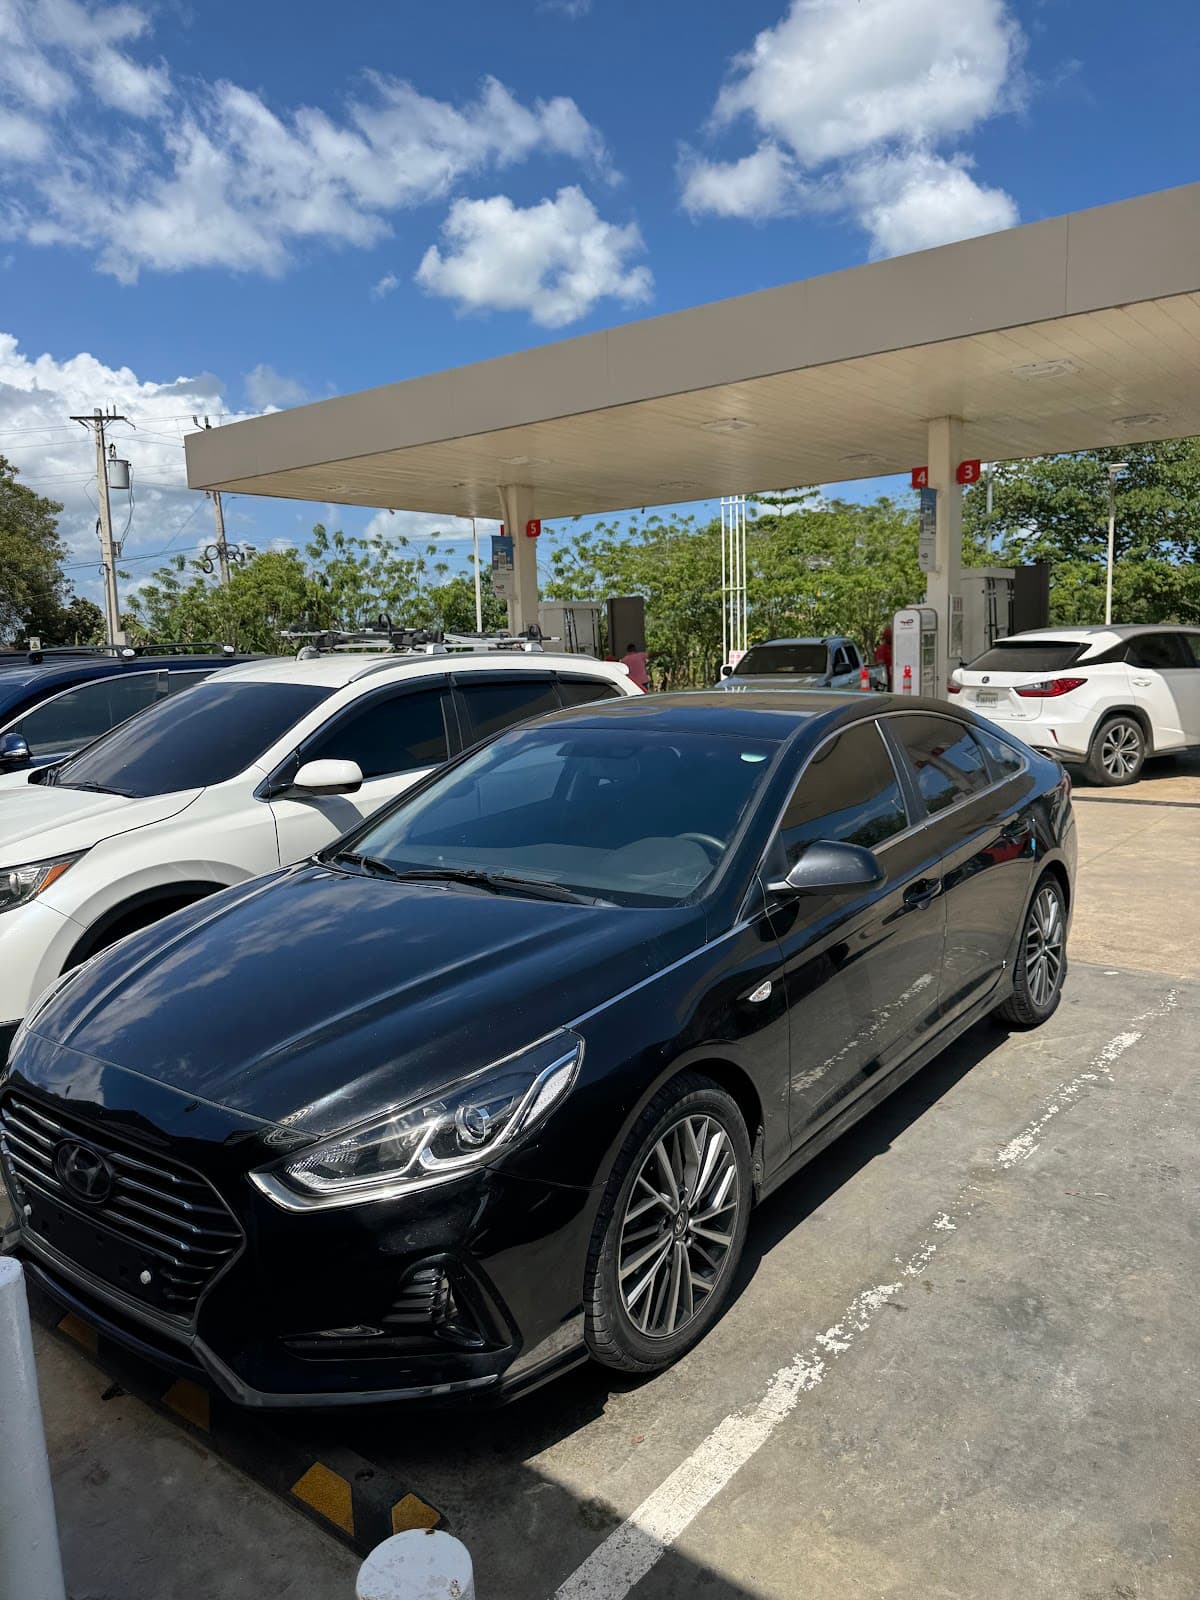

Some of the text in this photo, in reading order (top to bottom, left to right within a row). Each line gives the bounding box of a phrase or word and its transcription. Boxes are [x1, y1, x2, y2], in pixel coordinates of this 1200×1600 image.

[917, 471, 926, 484] 4
[964, 465, 973, 479] 3
[530, 523, 537, 534] 5
